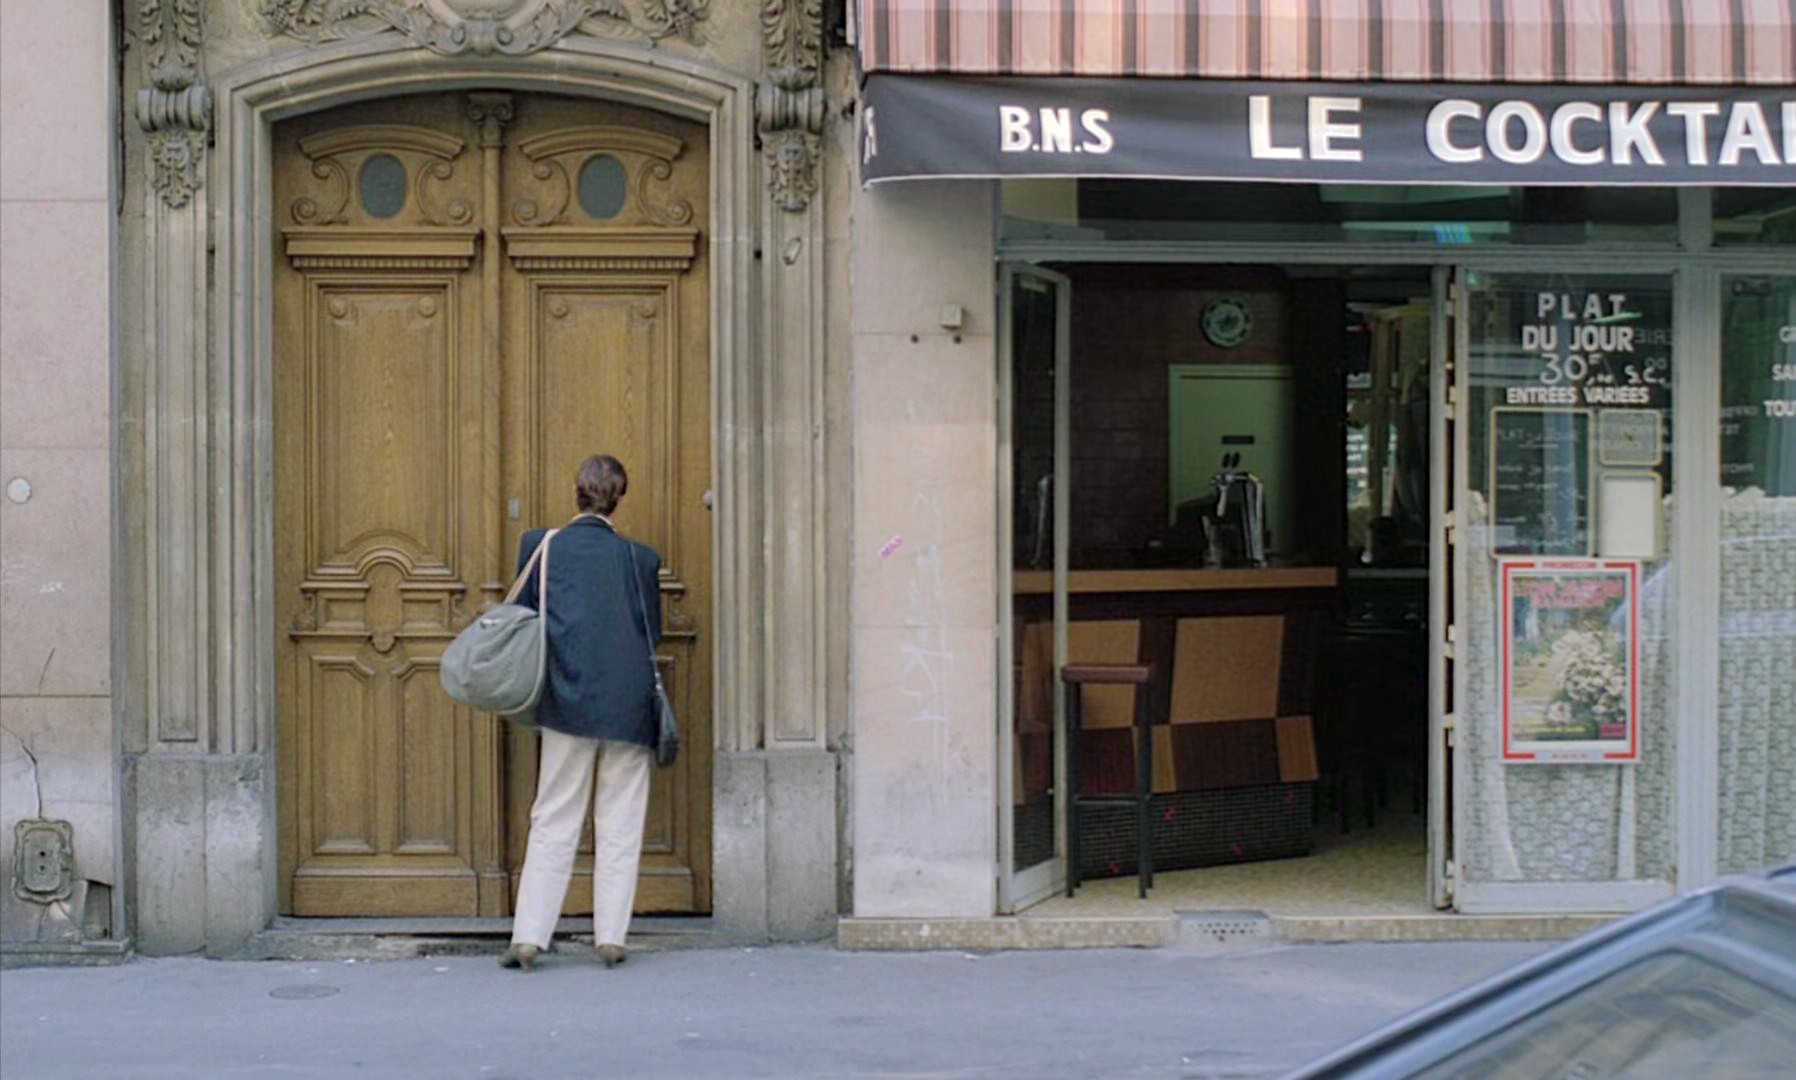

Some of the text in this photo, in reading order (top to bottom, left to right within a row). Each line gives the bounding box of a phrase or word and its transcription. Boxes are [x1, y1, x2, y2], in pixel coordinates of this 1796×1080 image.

[999, 105, 1113, 154] B.N.S
[1249, 95, 1363, 162] LE
[1537, 292, 1627, 321] PLAT
[1522, 325, 1634, 352] DU JOUR
